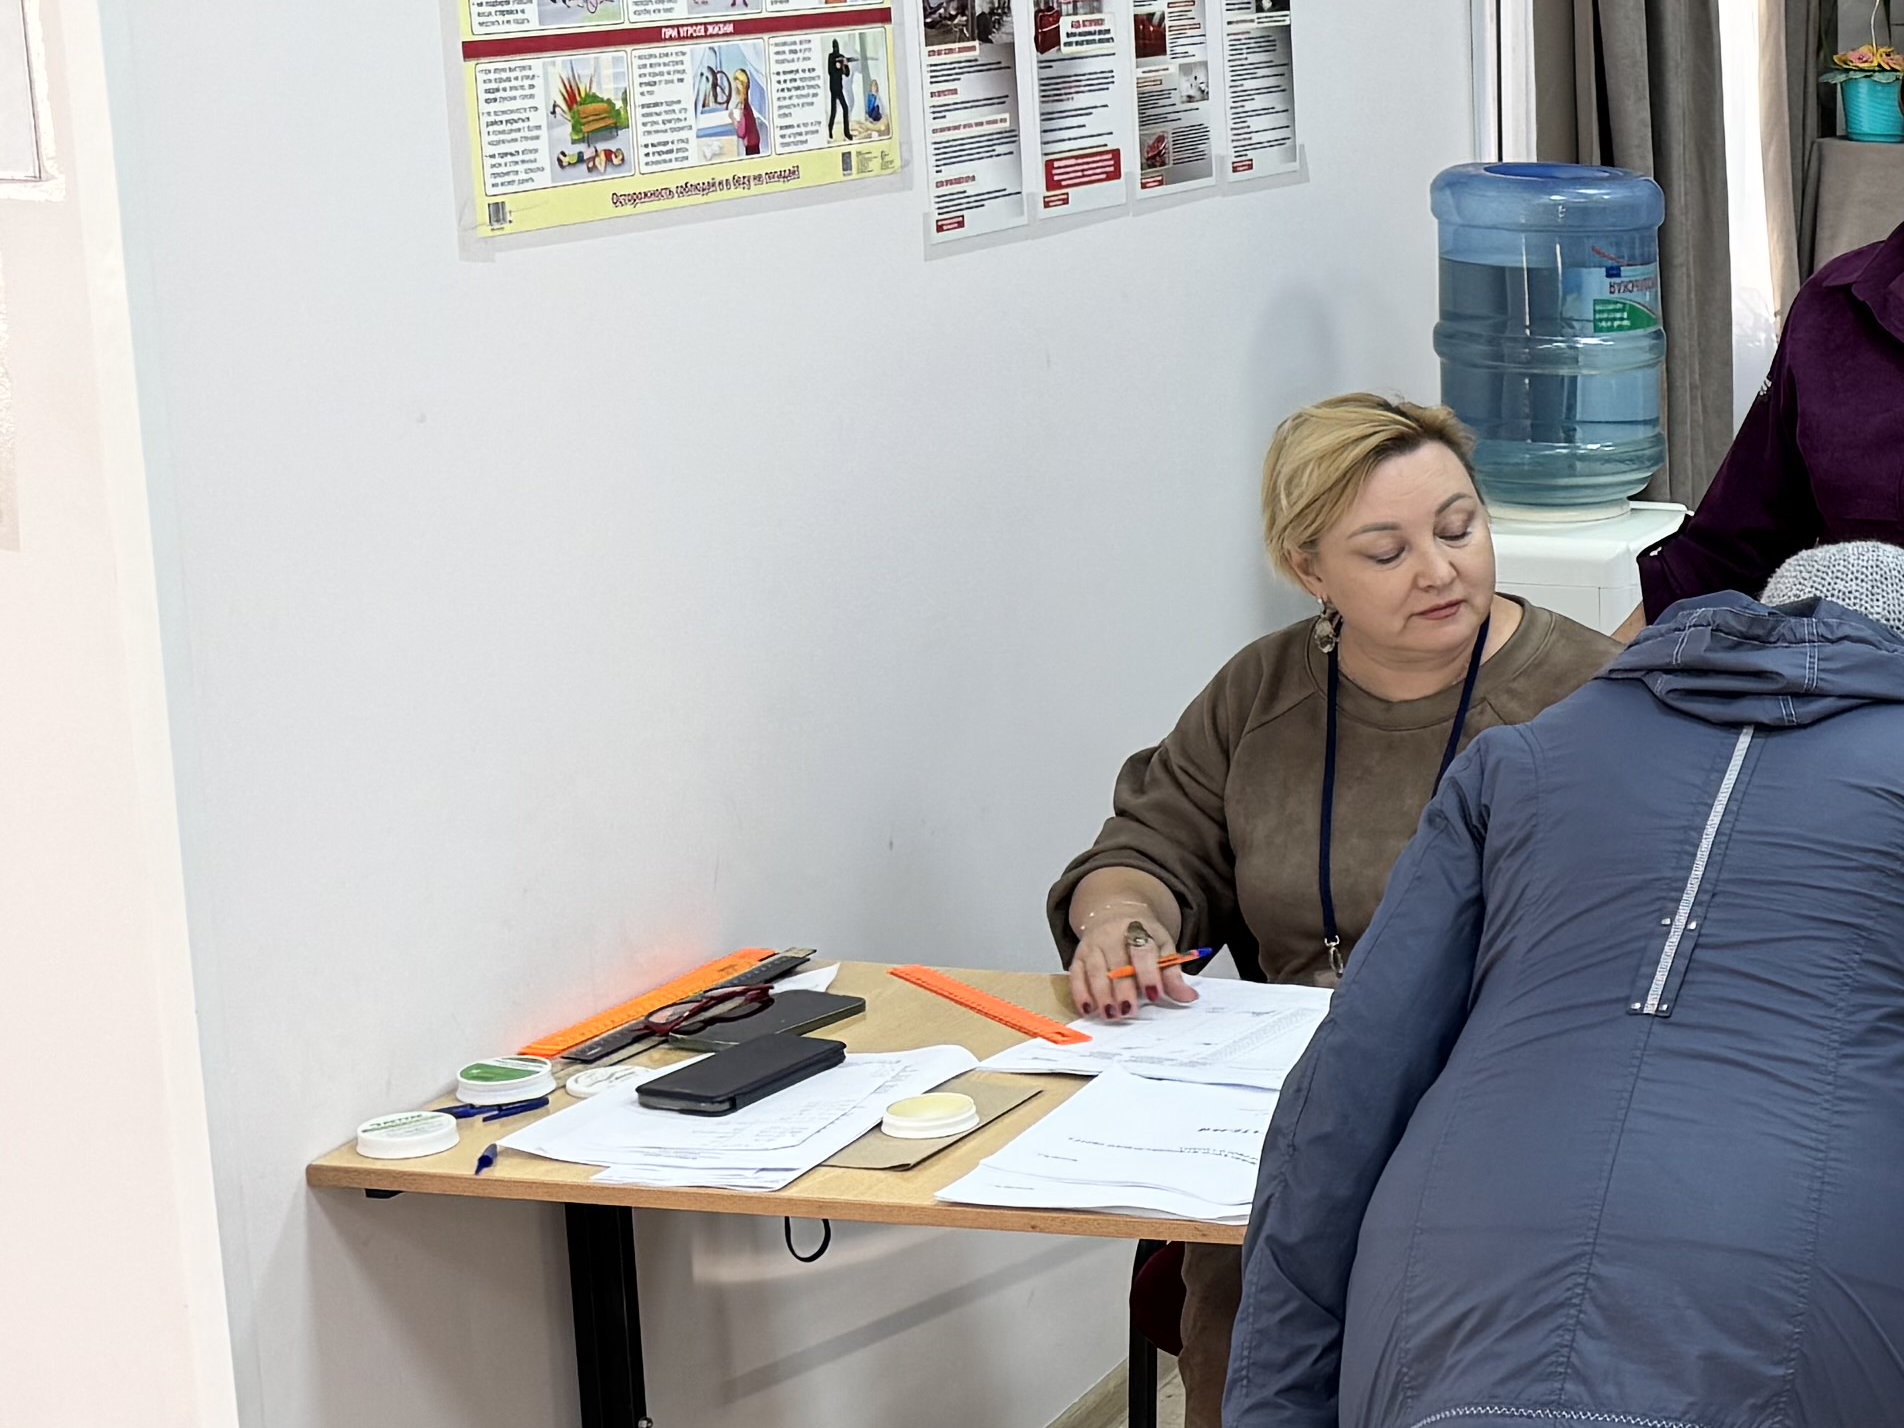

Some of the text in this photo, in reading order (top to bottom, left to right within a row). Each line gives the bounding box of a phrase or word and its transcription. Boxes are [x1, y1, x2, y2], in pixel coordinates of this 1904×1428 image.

[661, 27, 678, 38] ПРИ
[707, 23, 734, 35] ЖИЗНИ
[612, 189, 675, 208] Осторожность
